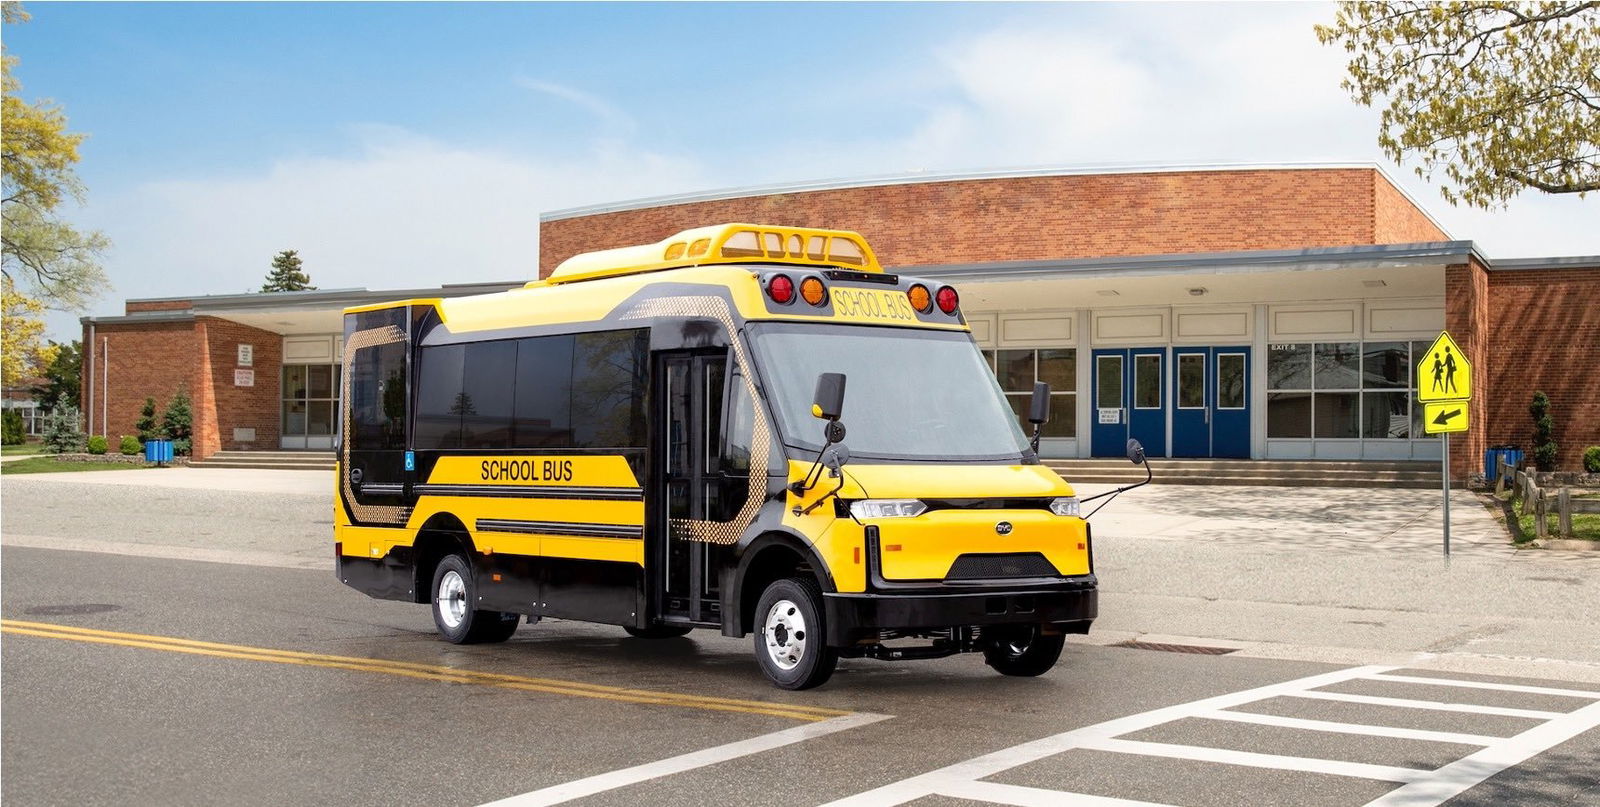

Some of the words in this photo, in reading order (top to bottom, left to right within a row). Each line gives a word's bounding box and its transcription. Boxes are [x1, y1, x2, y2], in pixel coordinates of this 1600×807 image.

[834, 289, 887, 318] SCHOOL
[884, 293, 911, 320] BUS
[481, 460, 539, 480] SCHOOL
[543, 460, 573, 481] BUS
